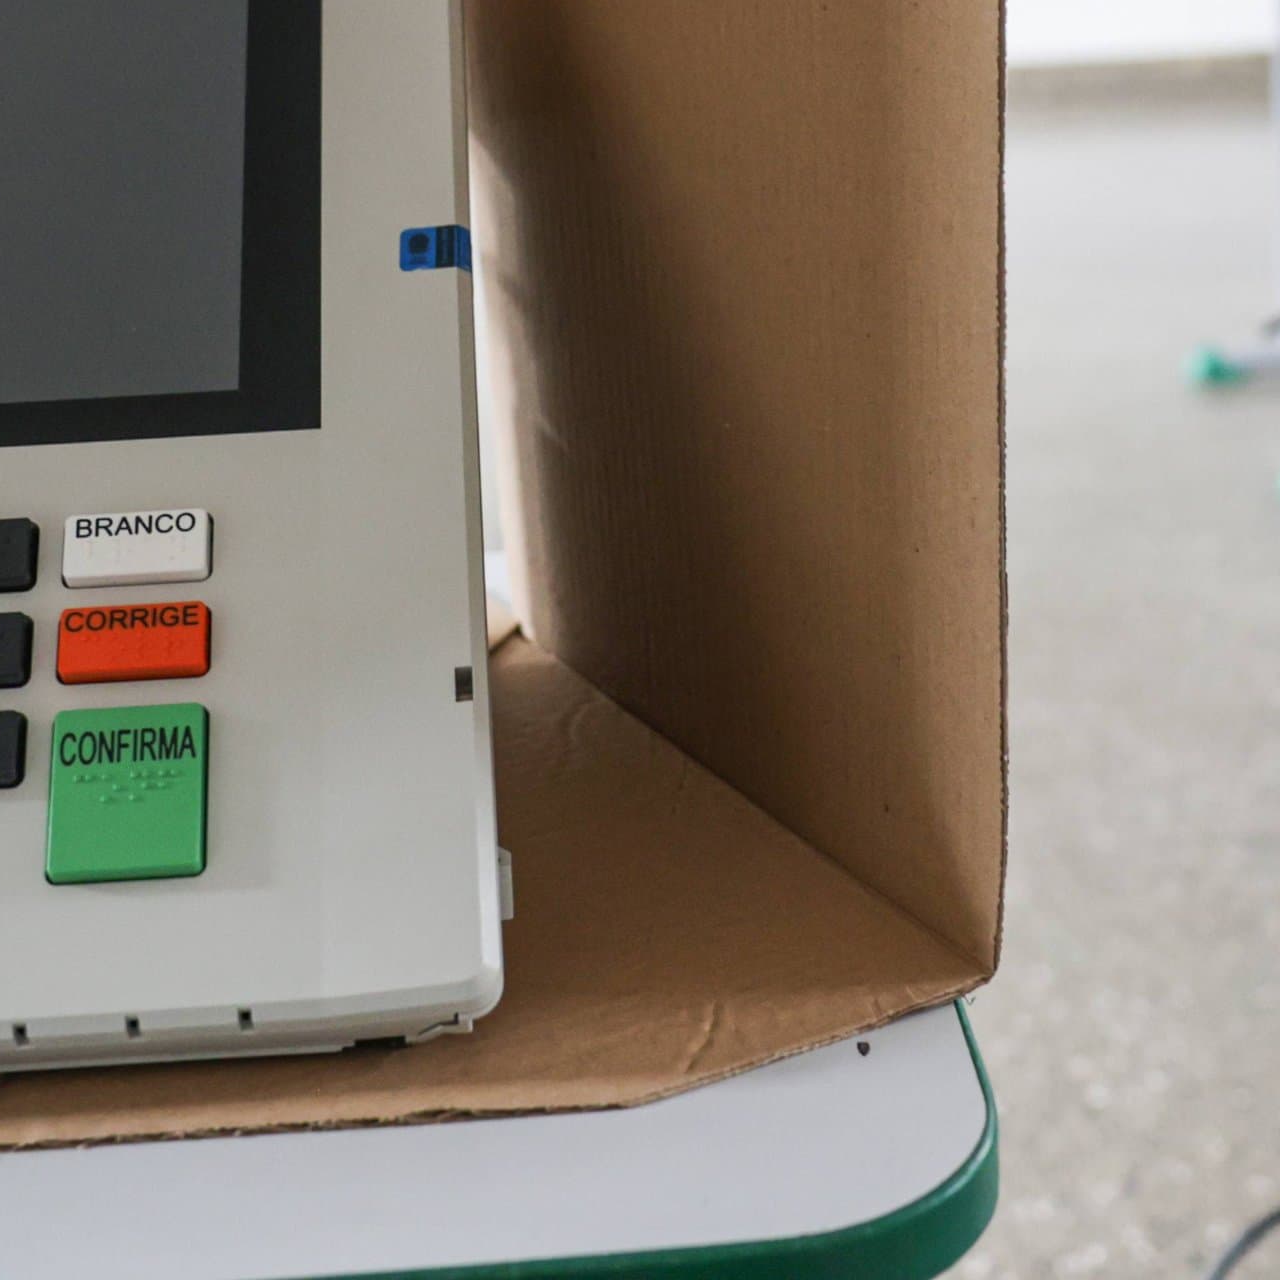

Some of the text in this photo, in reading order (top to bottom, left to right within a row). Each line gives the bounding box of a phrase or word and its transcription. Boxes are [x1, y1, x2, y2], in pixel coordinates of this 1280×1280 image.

[75, 512, 197, 539] BRANCO
[64, 604, 200, 633] CORRIGE
[59, 725, 197, 767] CONFIRMA
